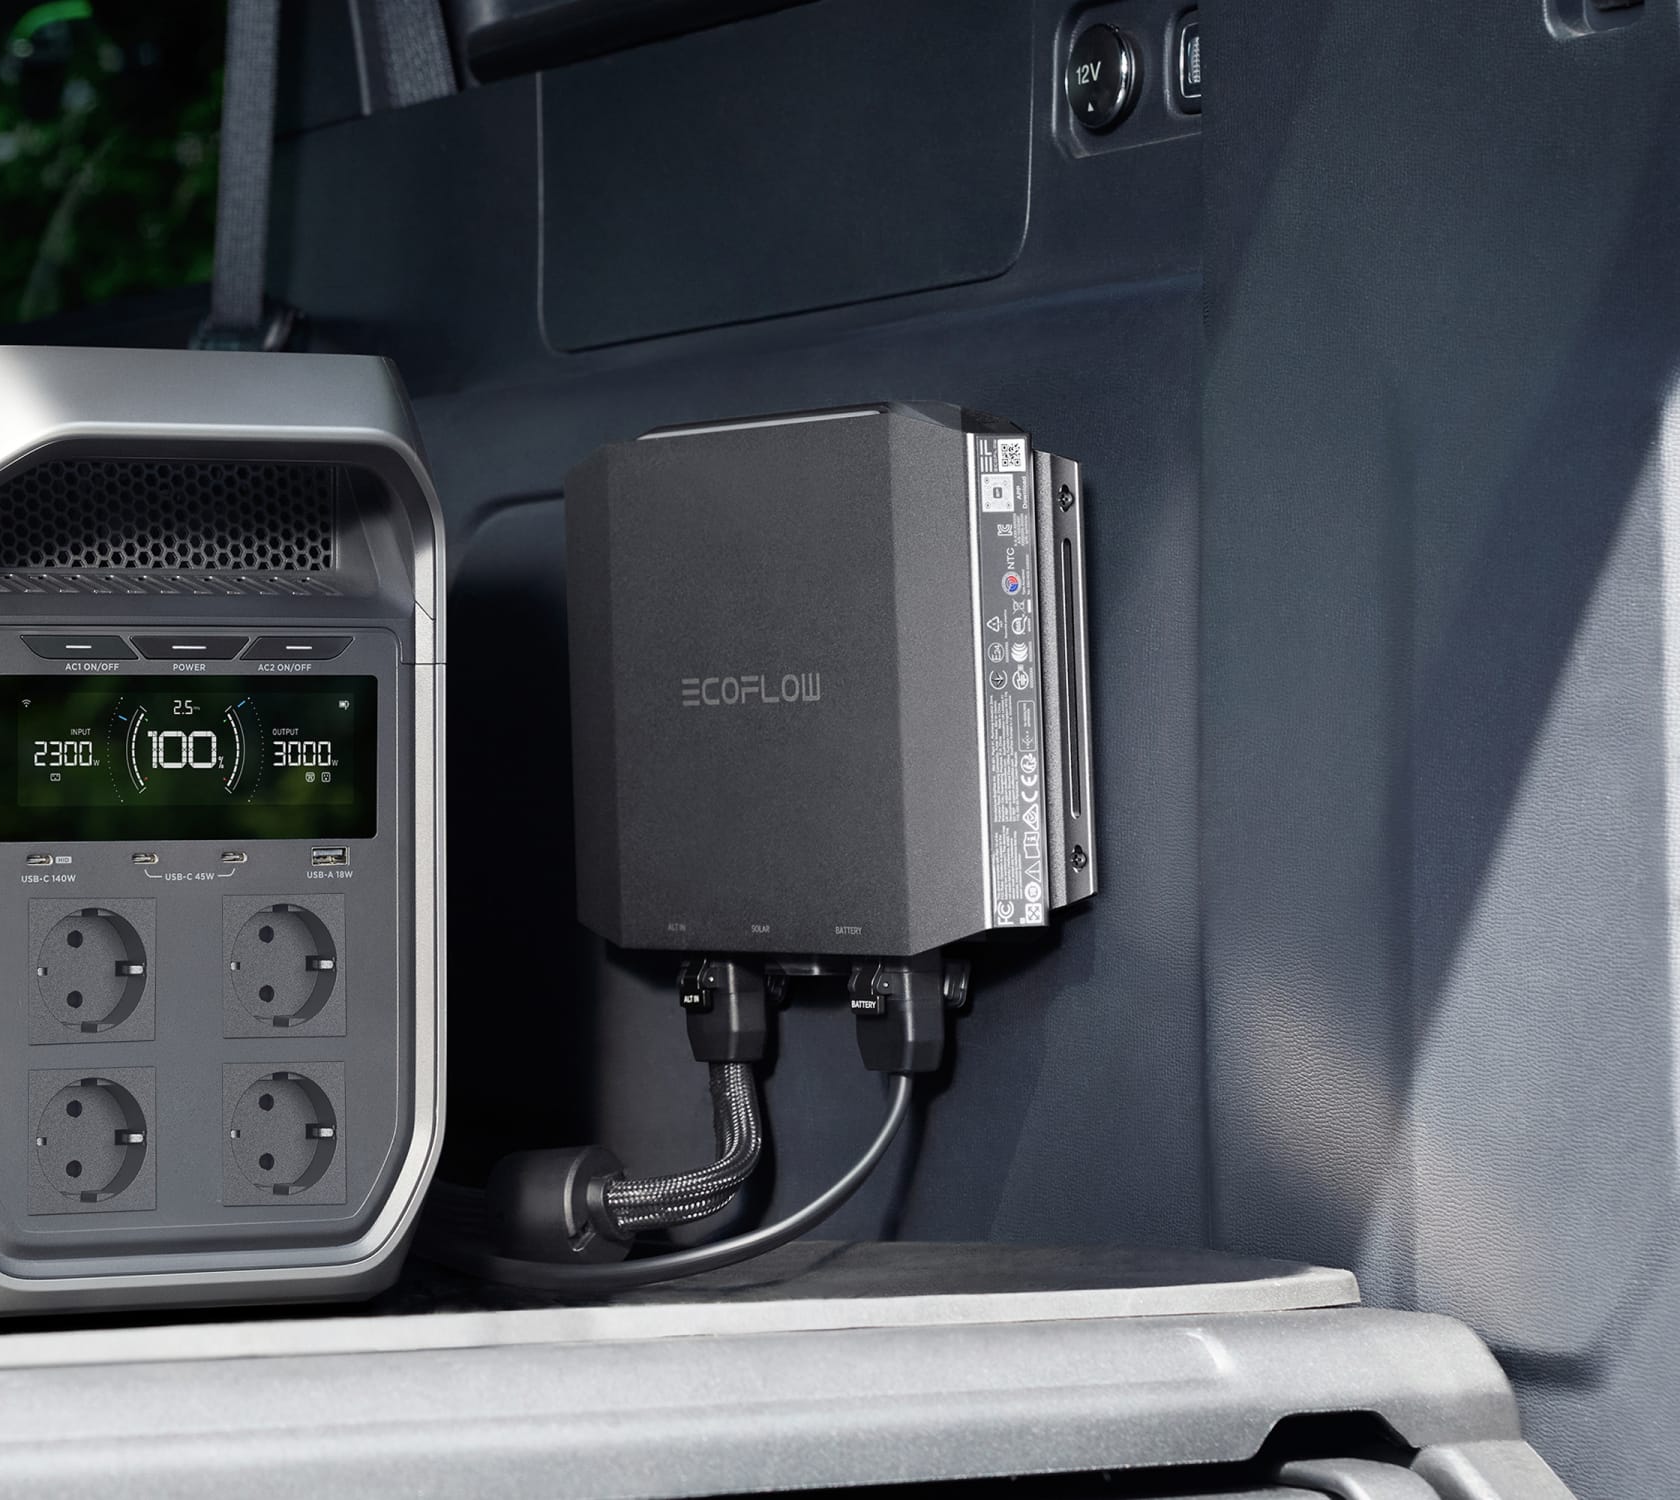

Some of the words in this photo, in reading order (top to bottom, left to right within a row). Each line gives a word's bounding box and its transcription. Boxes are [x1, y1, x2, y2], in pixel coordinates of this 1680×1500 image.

[1076, 61, 1101, 85] 12V
[1006, 547, 1015, 569] NTC
[65, 663, 82, 671] AC1
[83, 663, 120, 671] ON/OFF
[173, 663, 206, 672] POWER
[258, 664, 276, 672] AC2
[277, 663, 312, 672] ON/OFF
[681, 672, 820, 706] ECOFLOW
[173, 700, 193, 714] 2.5
[272, 728, 299, 736] OUTPUT
[21, 875, 50, 883] USB-C
[52, 874, 76, 882] 140W
[165, 873, 193, 881] USB-C
[195, 872, 215, 880] 45W
[307, 871, 334, 879] USB-A
[335, 870, 353, 878] 18W
[668, 923, 678, 932] ALT
[678, 923, 686, 932] IN
[751, 925, 770, 933] SOLAR
[835, 926, 862, 935] BATTERY
[684, 995, 693, 1003] ALT
[693, 994, 700, 1003] IN
[851, 1000, 876, 1009] BATTERY
